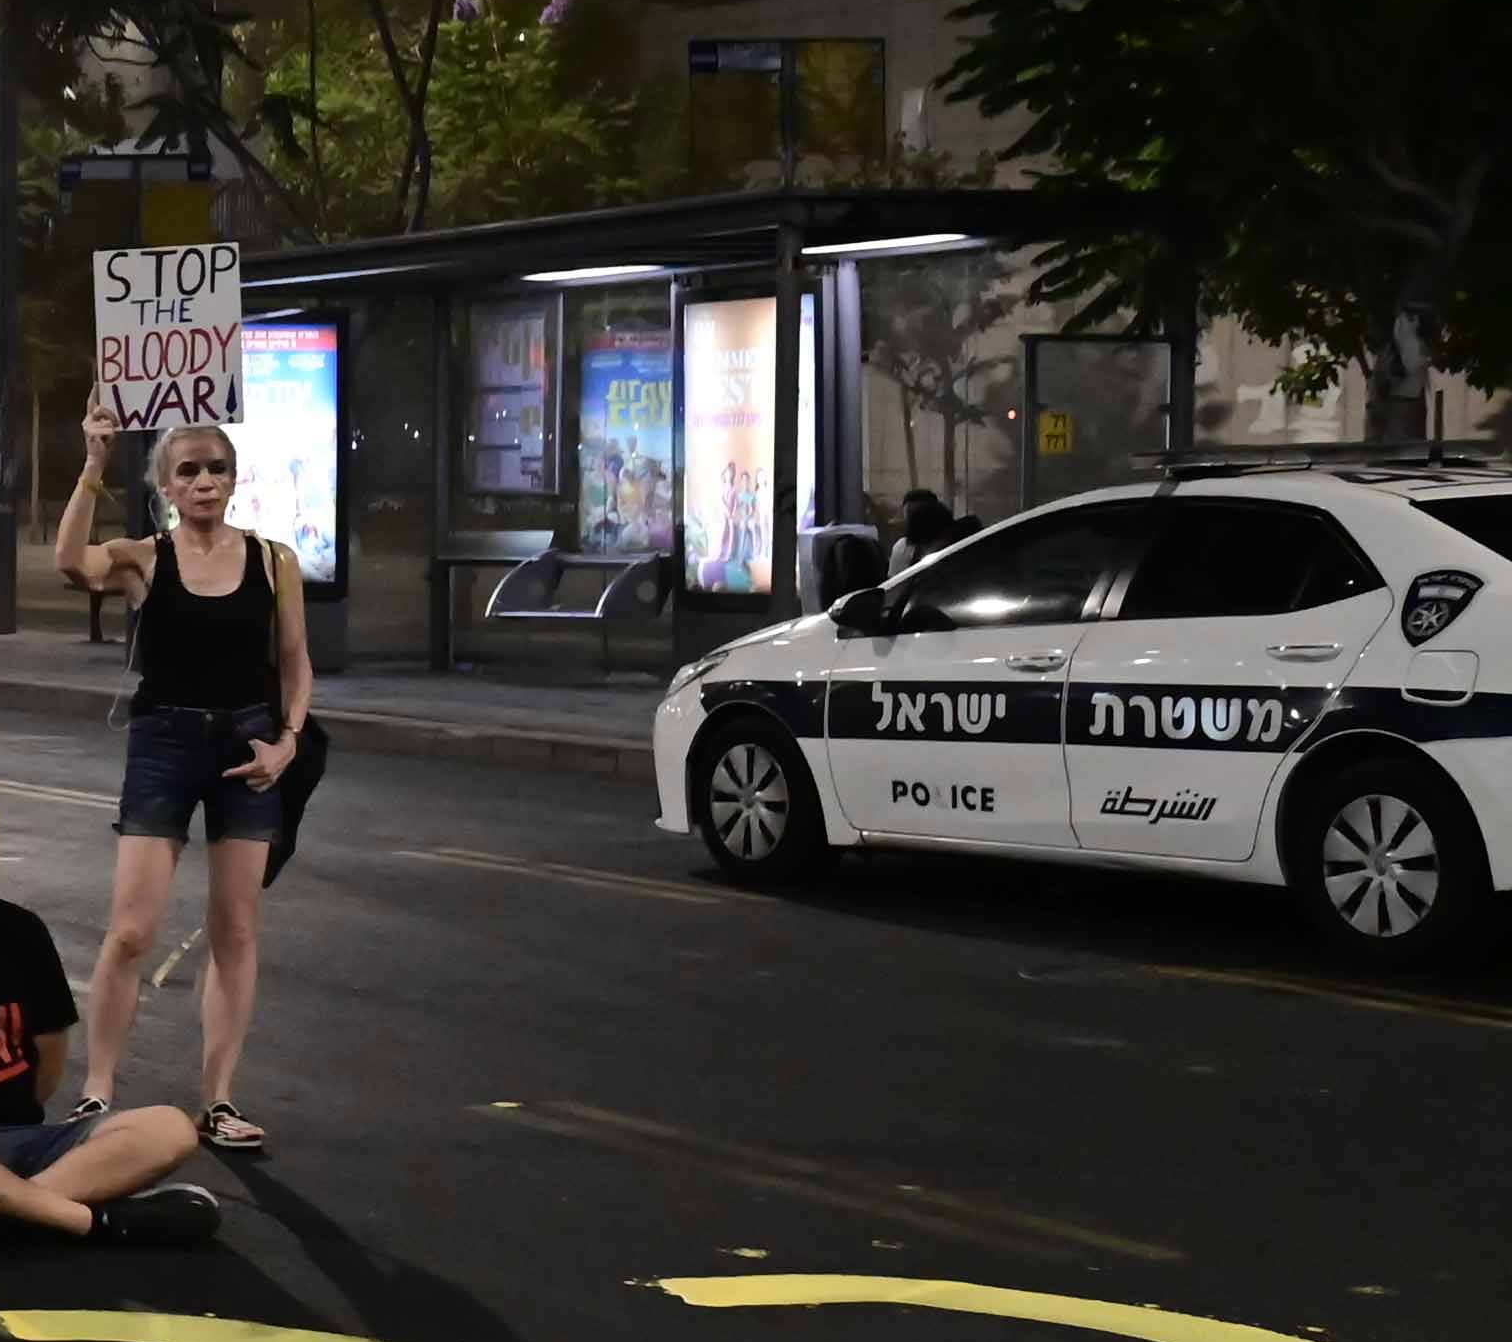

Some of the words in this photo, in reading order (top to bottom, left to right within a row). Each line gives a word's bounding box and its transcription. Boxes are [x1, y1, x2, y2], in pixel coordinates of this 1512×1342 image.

[105, 245, 238, 303] STOP
[130, 297, 195, 326] THE
[101, 322, 240, 383] BLOODY
[871, 680, 1007, 735] ישראל
[1088, 690, 1284, 743] משטרת
[1099, 785, 1218, 824] الشرطة
